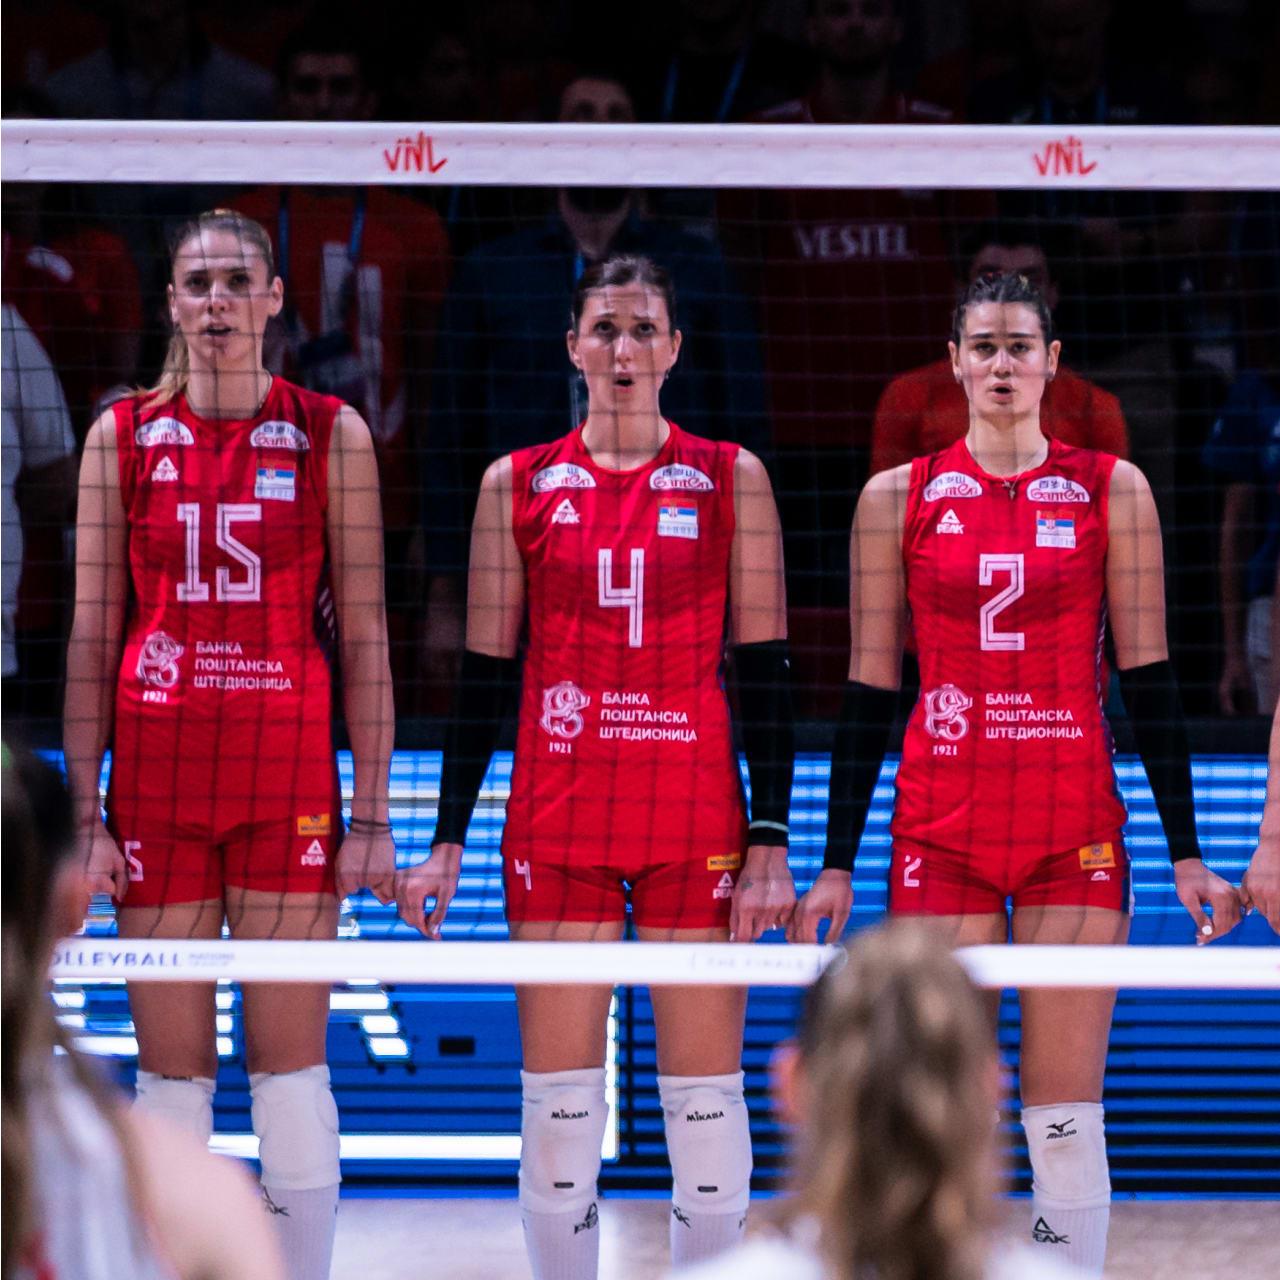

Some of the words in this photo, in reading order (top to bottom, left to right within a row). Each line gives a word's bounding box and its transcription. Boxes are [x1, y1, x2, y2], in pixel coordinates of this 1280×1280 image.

[384, 132, 447, 173] VNL
[1033, 136, 1096, 176] VNL
[792, 223, 909, 258] VESTEL
[936, 524, 964, 534] PEAK
[177, 503, 262, 602] 15
[599, 549, 644, 648] 4
[979, 553, 1025, 651] 2
[196, 642, 242, 655] БАНКА
[195, 659, 283, 673] ПОШТАНСКА
[194, 675, 292, 690] ШТЕДИОНИЦА
[602, 692, 649, 705] БАНКА
[985, 693, 1032, 705] БАНКА
[601, 709, 688, 723] ПОШТАНСКА
[985, 710, 1073, 722] ПОШТАНСКА
[600, 726, 697, 742] ШТЕДИОНИЦА
[985, 727, 1083, 740] ШТЕДИОНИЦА
[549, 742, 571, 753] 1921
[932, 745, 958, 756] 1921
[301, 855, 326, 866] PEAK
[514, 859, 531, 890] 4
[904, 855, 921, 887] 2
